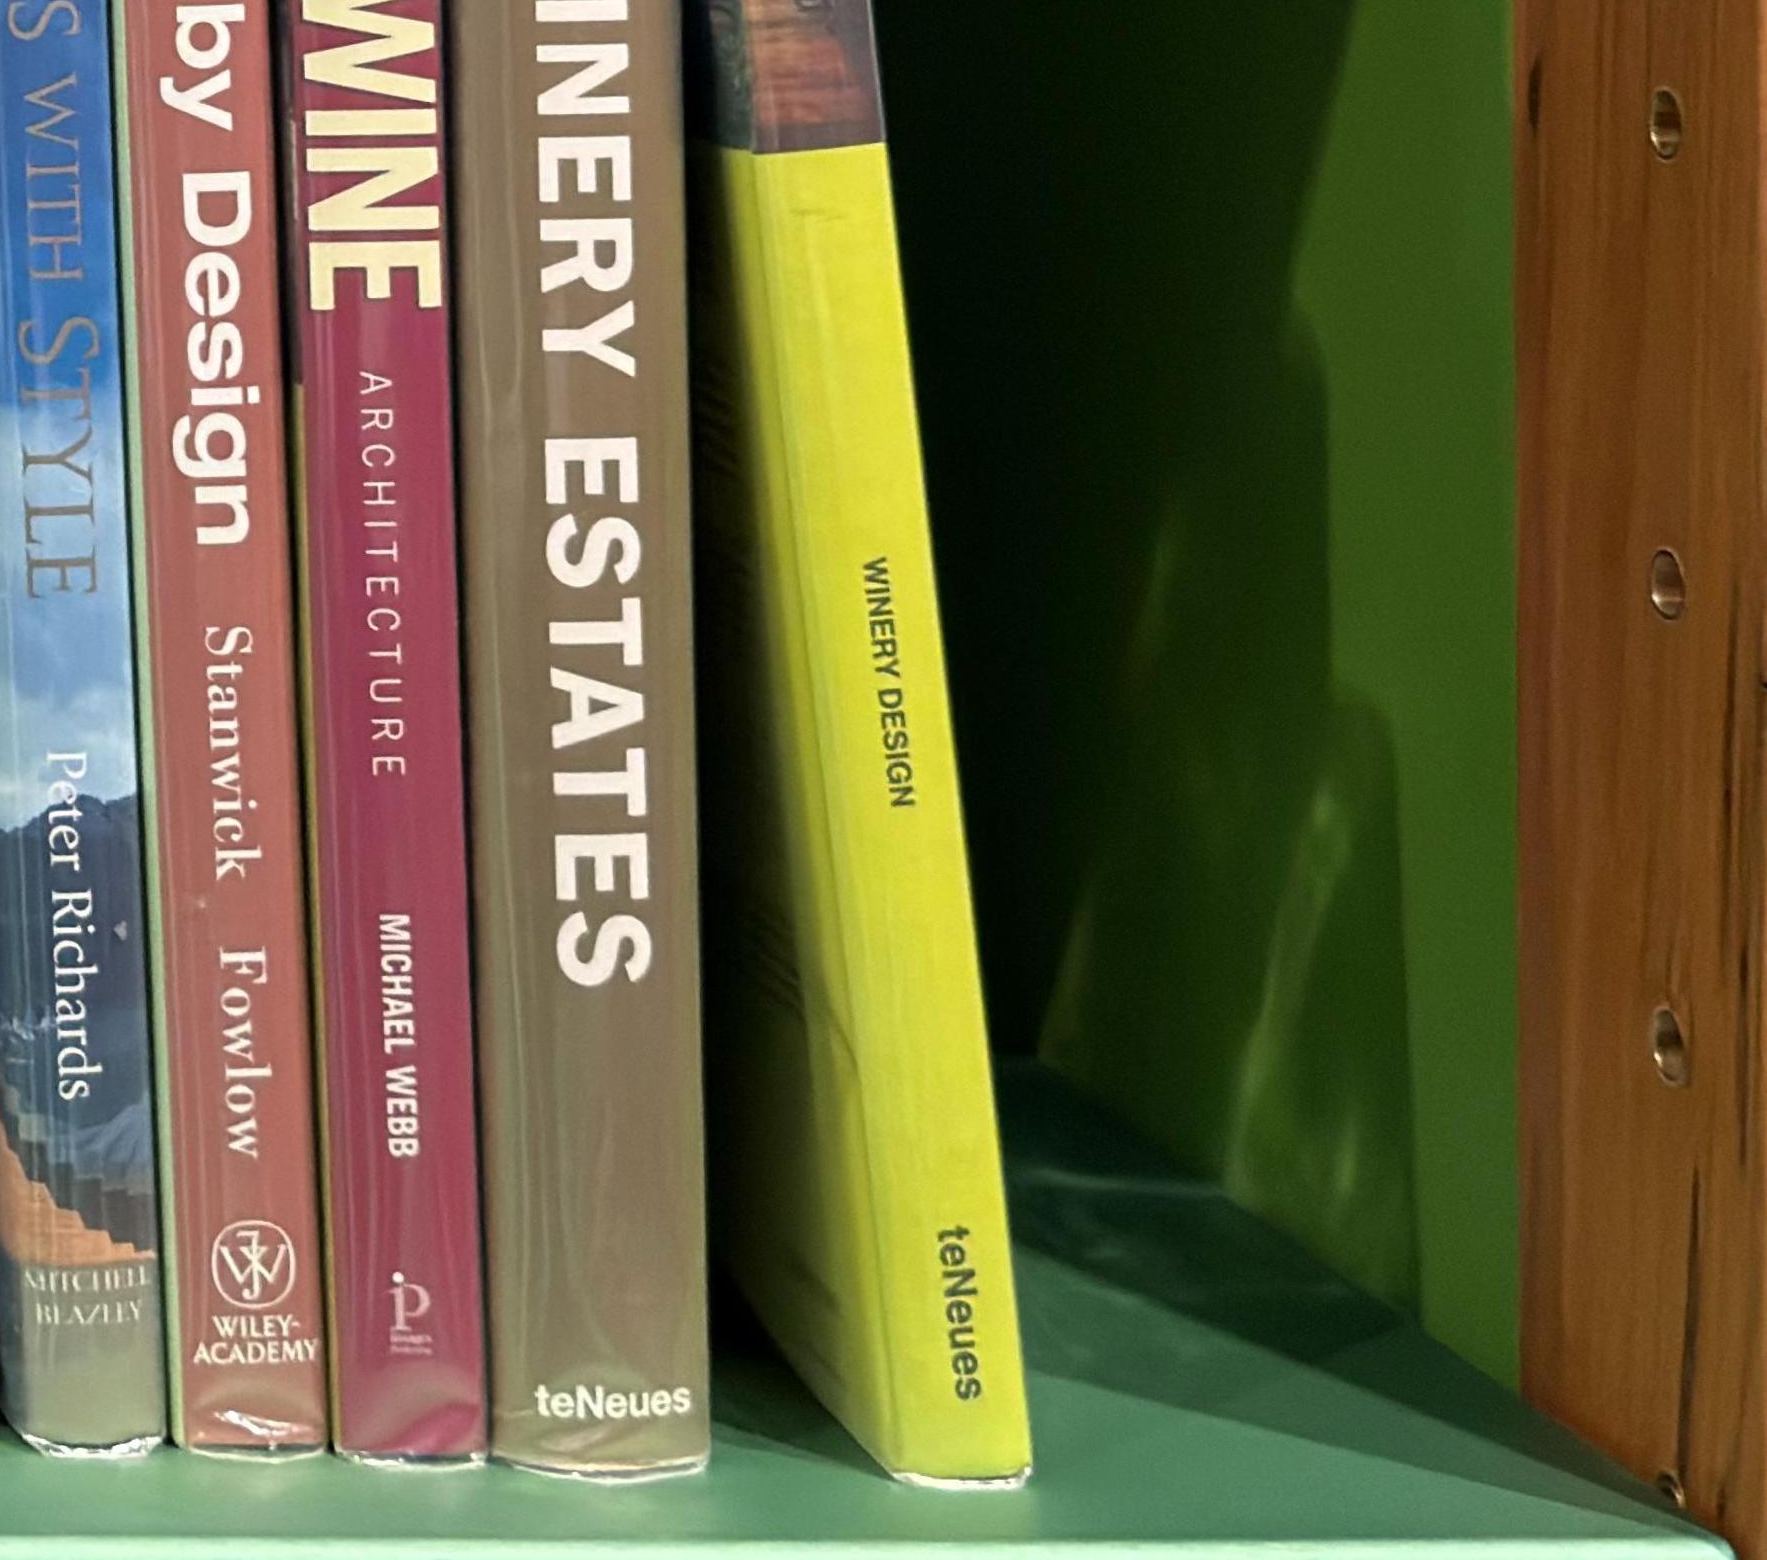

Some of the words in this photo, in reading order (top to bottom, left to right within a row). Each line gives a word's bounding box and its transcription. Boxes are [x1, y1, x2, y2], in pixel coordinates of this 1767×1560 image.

[160, 3, 247, 132] by
[23, 72, 85, 282] WITH
[172, 169, 261, 546] Design
[18, 316, 101, 599] STYLE
[359, 370, 406, 776] ARCHITECTURE
[863, 556, 902, 680] WINERY
[203, 625, 263, 881] Stanwick
[544, 435, 653, 987] ESTATES
[877, 687, 917, 808] DESIGN
[46, 750, 88, 873] Peter
[50, 888, 103, 1102] Richards
[219, 945, 273, 1160] Fowlow
[379, 913, 418, 1055] MICHAEL
[385, 1065, 421, 1159] WEBB
[193, 1338, 319, 1365] ACADEMY
[212, 1314, 302, 1338] WILEY-
[937, 1225, 983, 1402] teNeues
[534, 1384, 692, 1420] teNeues
